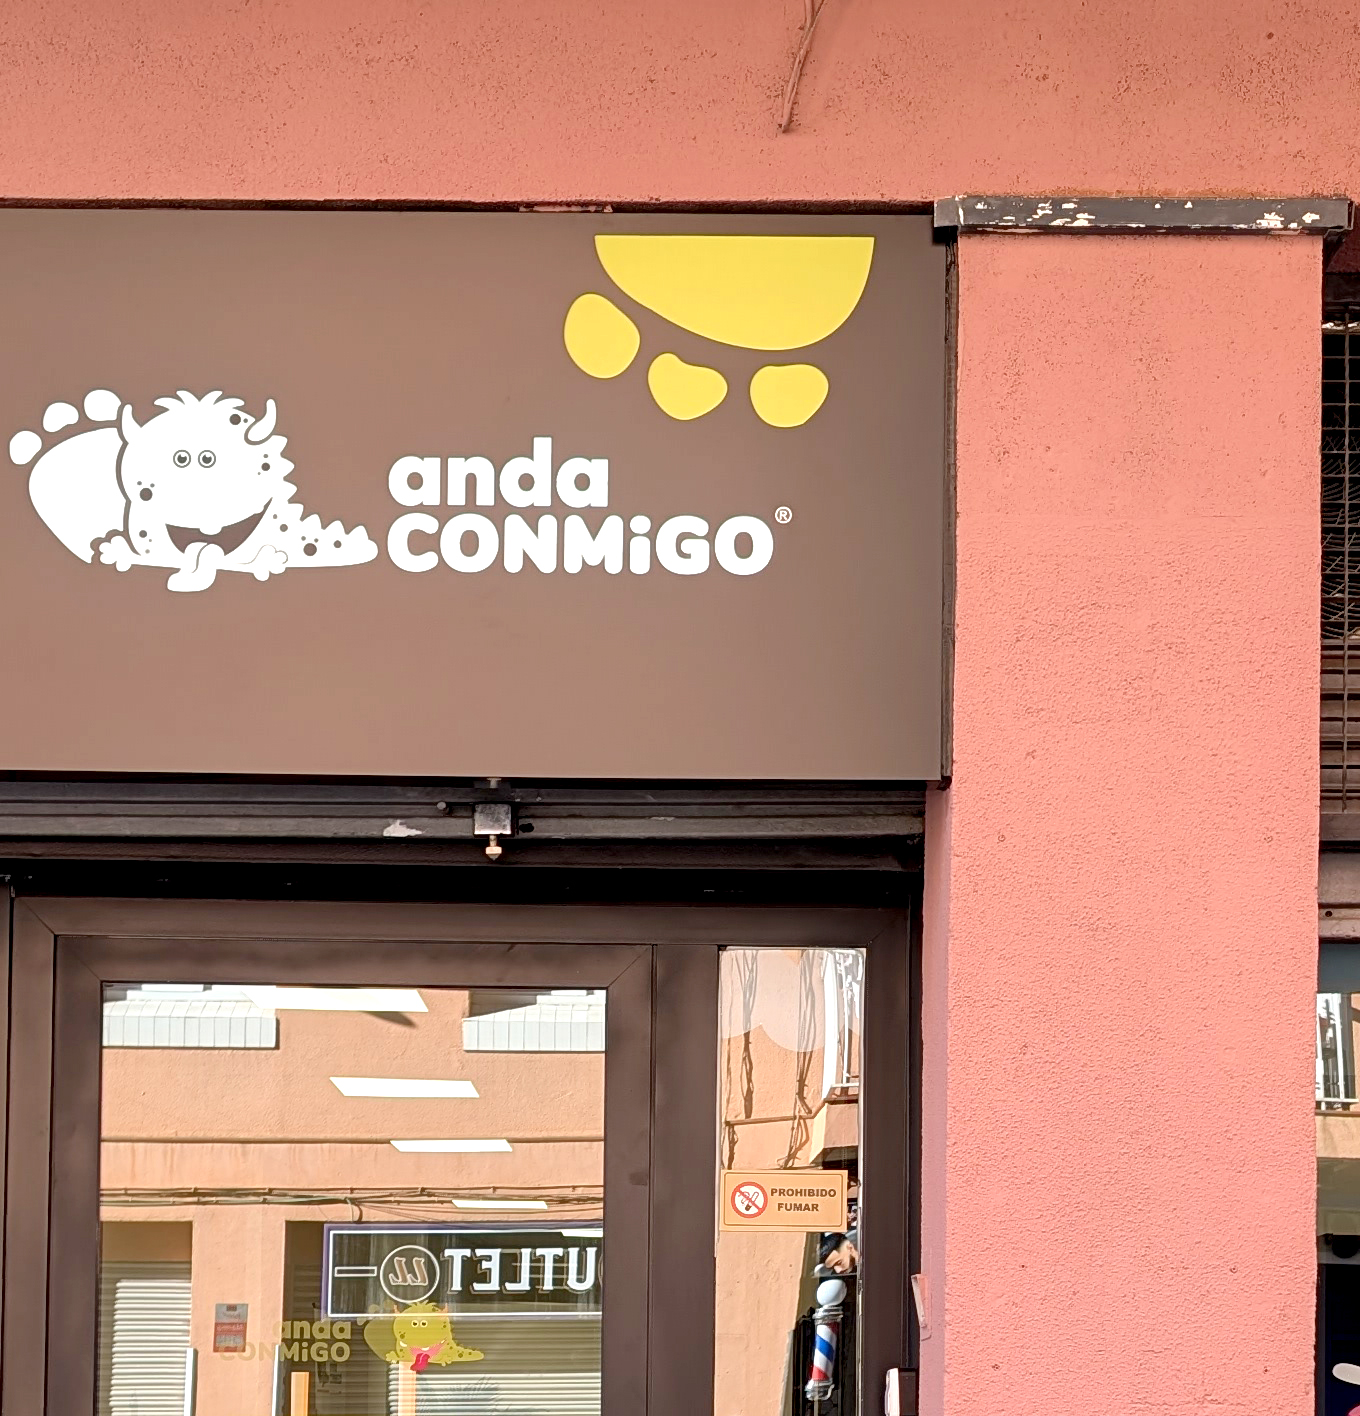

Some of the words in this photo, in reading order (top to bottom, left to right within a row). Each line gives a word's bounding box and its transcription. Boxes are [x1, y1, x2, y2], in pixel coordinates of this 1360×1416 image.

[388, 437, 609, 508] anda
[771, 1188, 837, 1198] PROHIBIDO
[777, 1203, 819, 1212] FUMAR
[272, 1317, 352, 1339] anda
